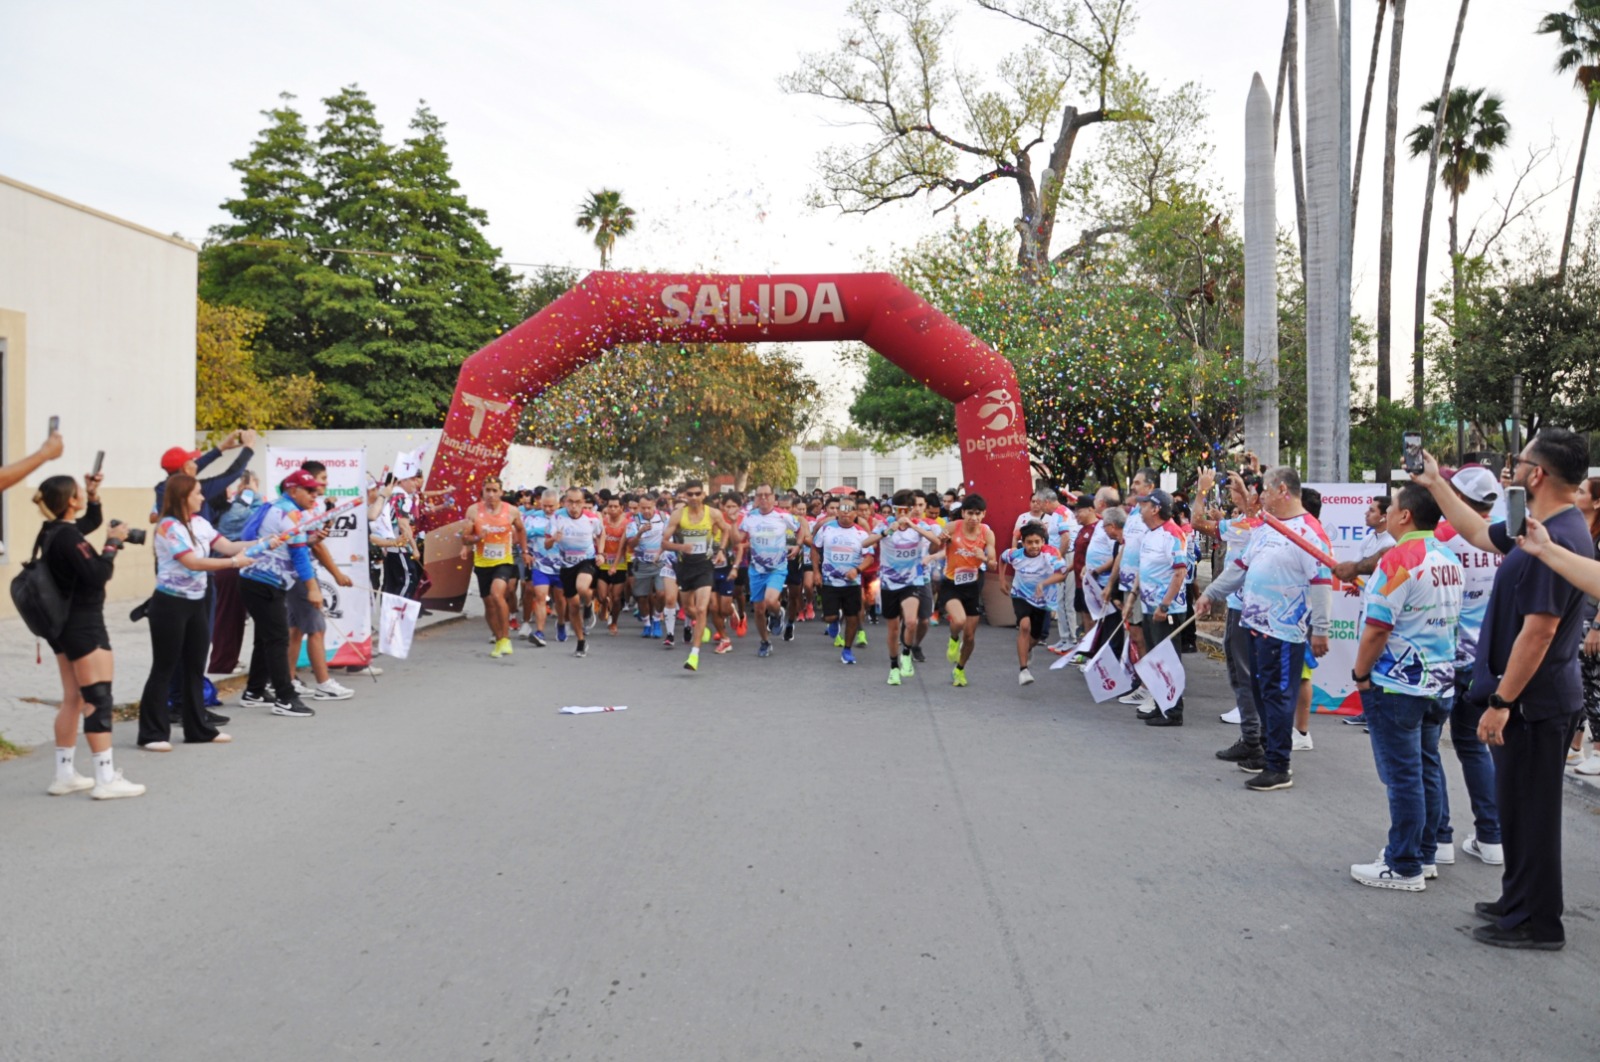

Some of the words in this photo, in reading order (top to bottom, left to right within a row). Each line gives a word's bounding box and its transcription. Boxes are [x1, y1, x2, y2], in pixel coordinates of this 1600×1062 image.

[661, 283, 845, 325] SALIDA
[1321, 495, 1364, 505] ecemos
[832, 553, 851, 562] 637
[896, 549, 917, 559] 208
[1474, 553, 1489, 568] LA
